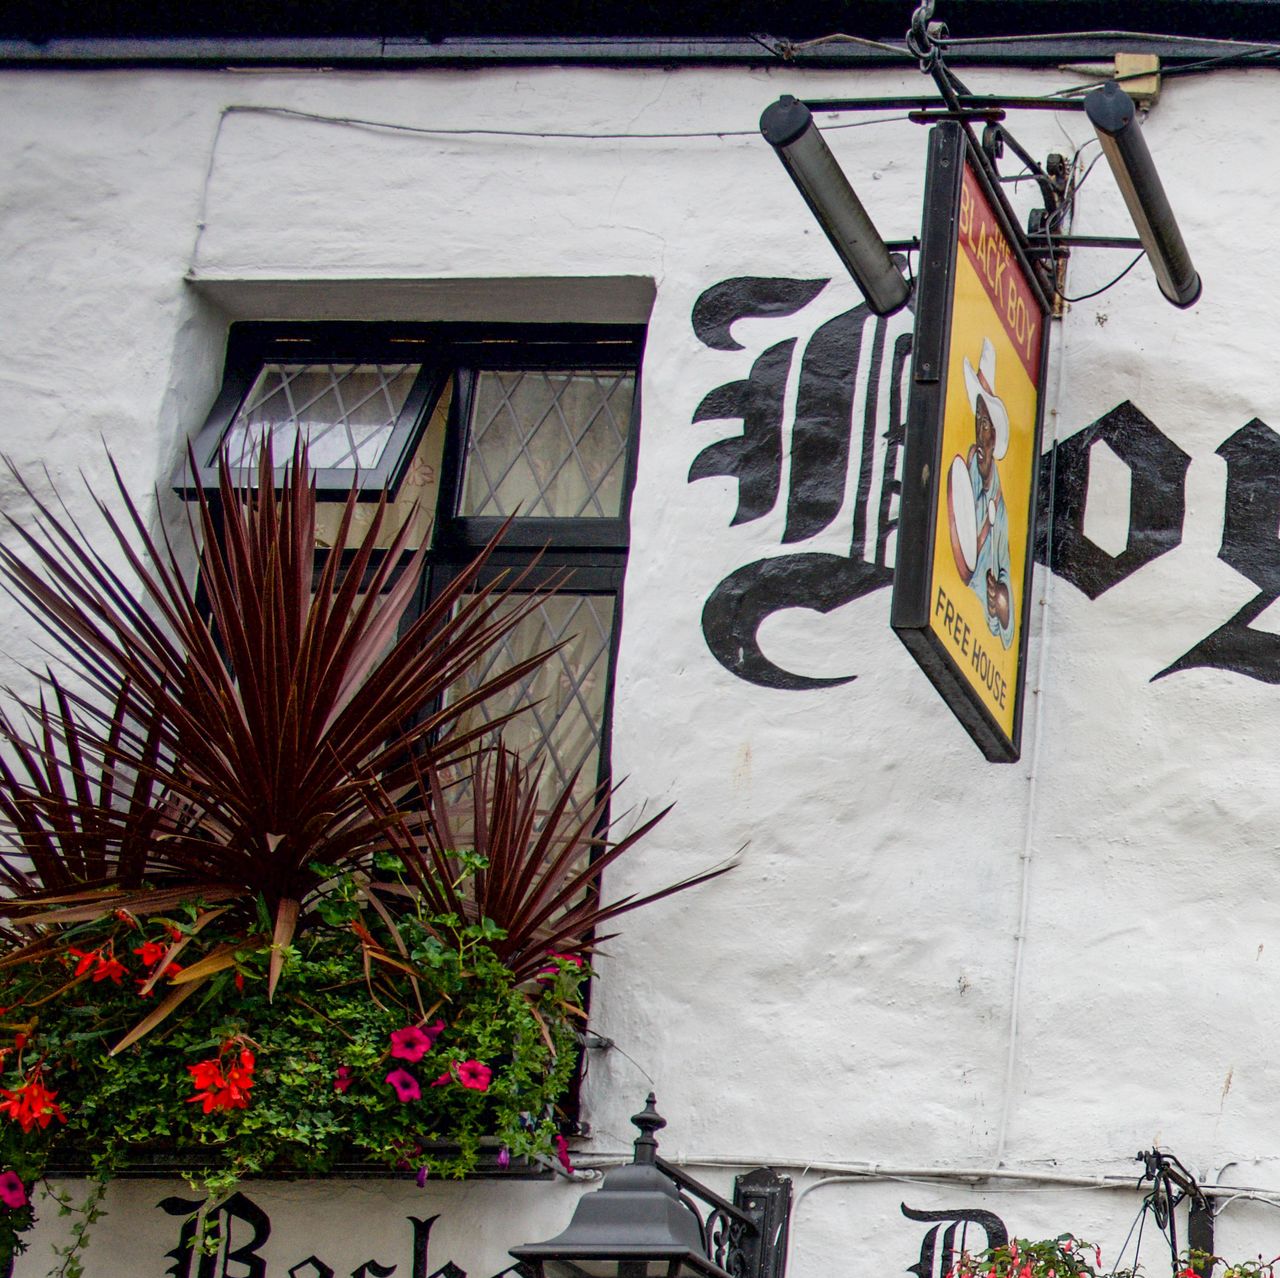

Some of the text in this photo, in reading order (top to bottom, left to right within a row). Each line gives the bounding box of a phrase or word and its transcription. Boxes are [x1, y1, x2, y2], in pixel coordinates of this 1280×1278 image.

[959, 181, 1036, 362] BLACK BOY
[994, 222, 1011, 268] THE
[935, 585, 1007, 711] FREE HOUSE
